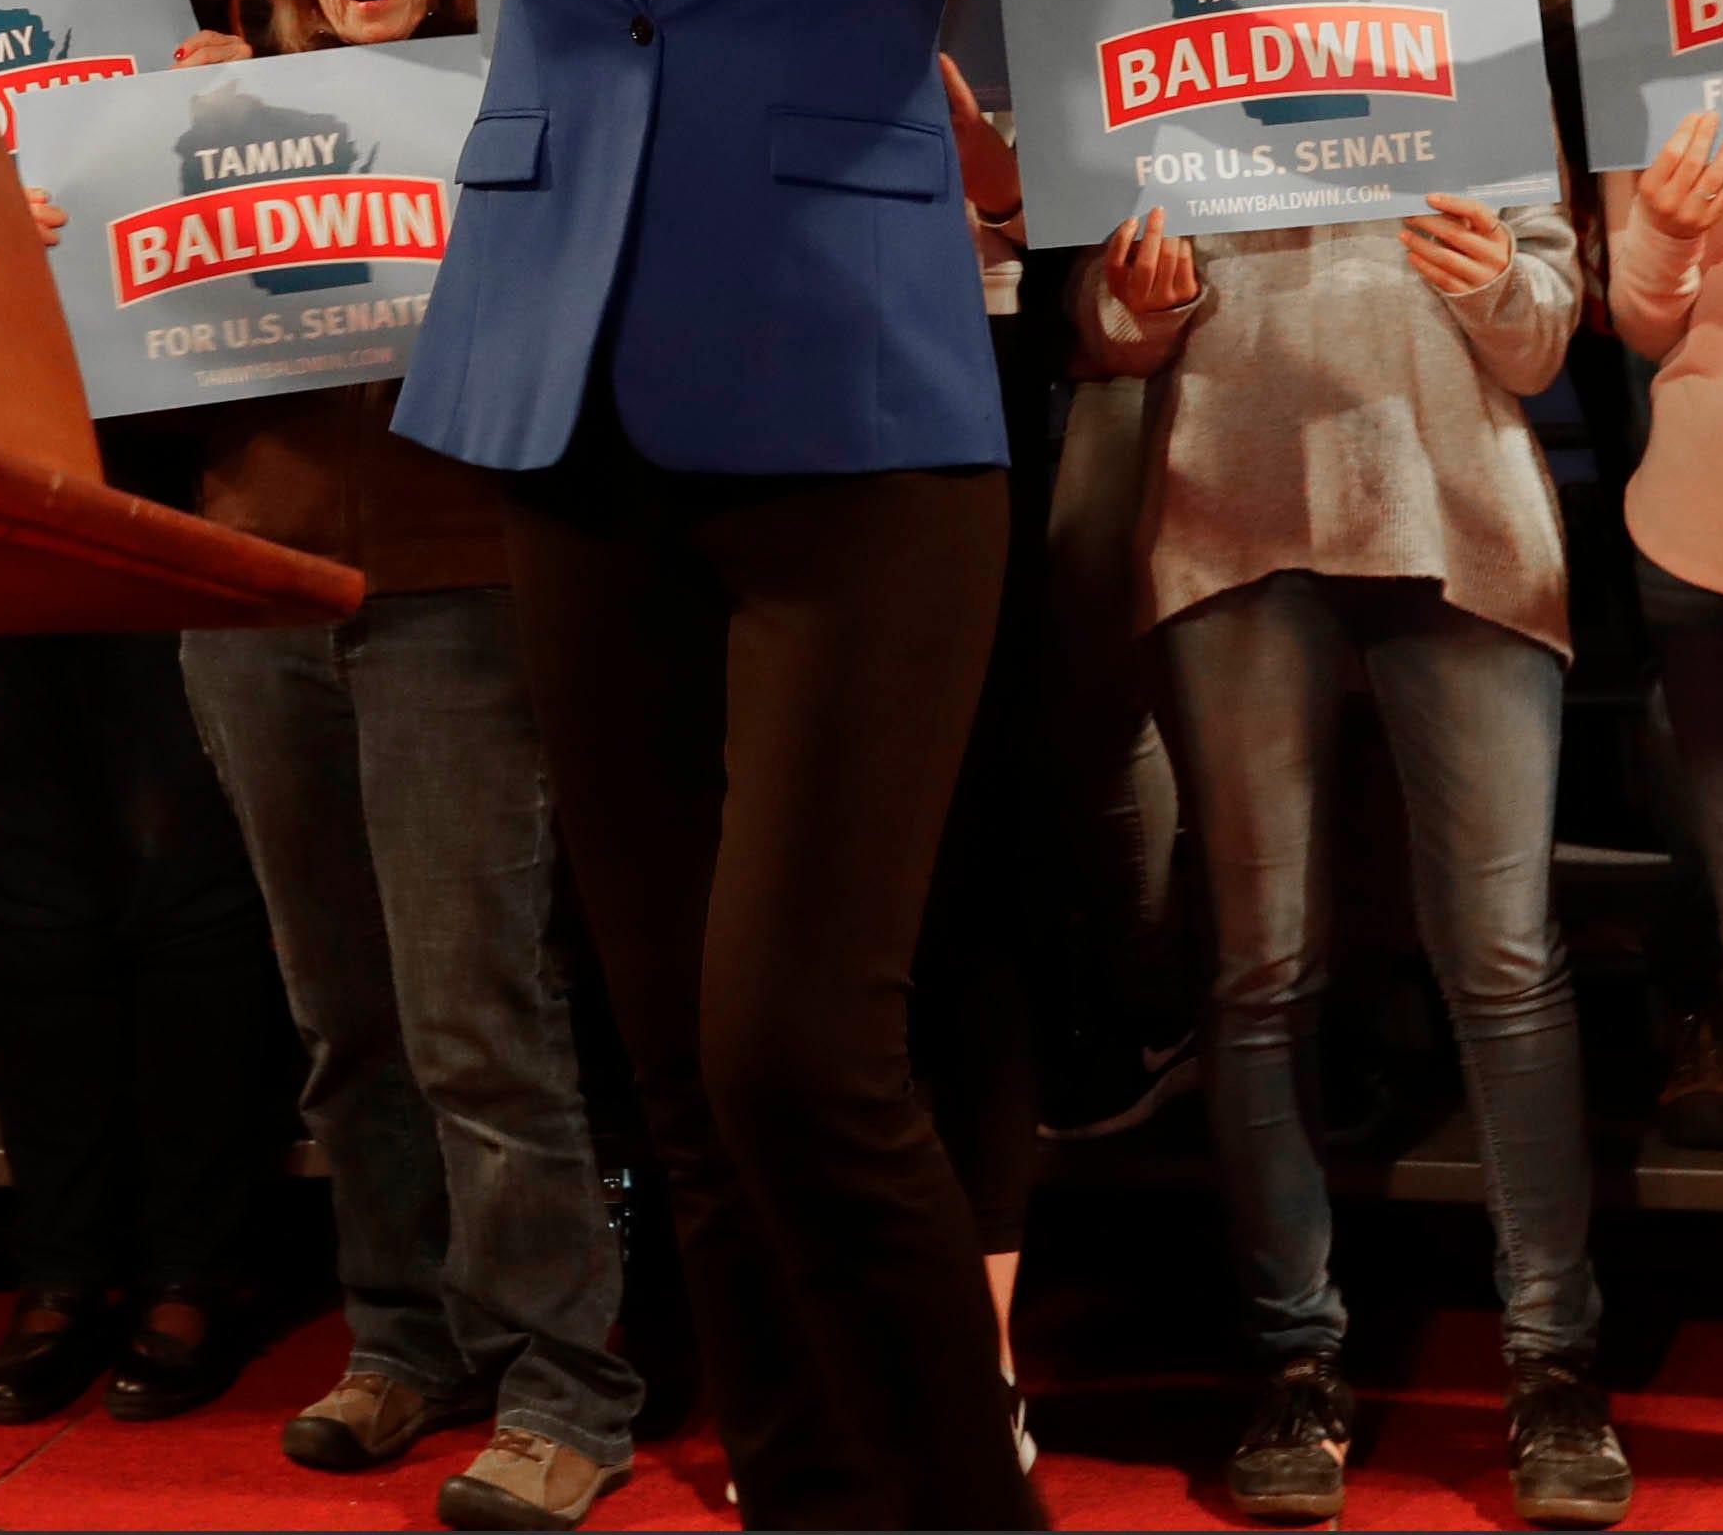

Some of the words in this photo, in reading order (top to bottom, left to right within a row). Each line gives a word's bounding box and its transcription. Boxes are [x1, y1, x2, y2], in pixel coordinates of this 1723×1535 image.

[1117, 20, 1439, 112] BALDWIN
[194, 133, 341, 182] TAMMY
[1135, 153, 1206, 186] FOR
[1215, 144, 1287, 178] U.S.
[1295, 130, 1436, 172] SENATE
[1186, 182, 1392, 218] TAMMYBALDWIN.COM
[127, 192, 437, 287] BALDWIN
[145, 323, 217, 360] FOR
[222, 313, 294, 348] U.S.
